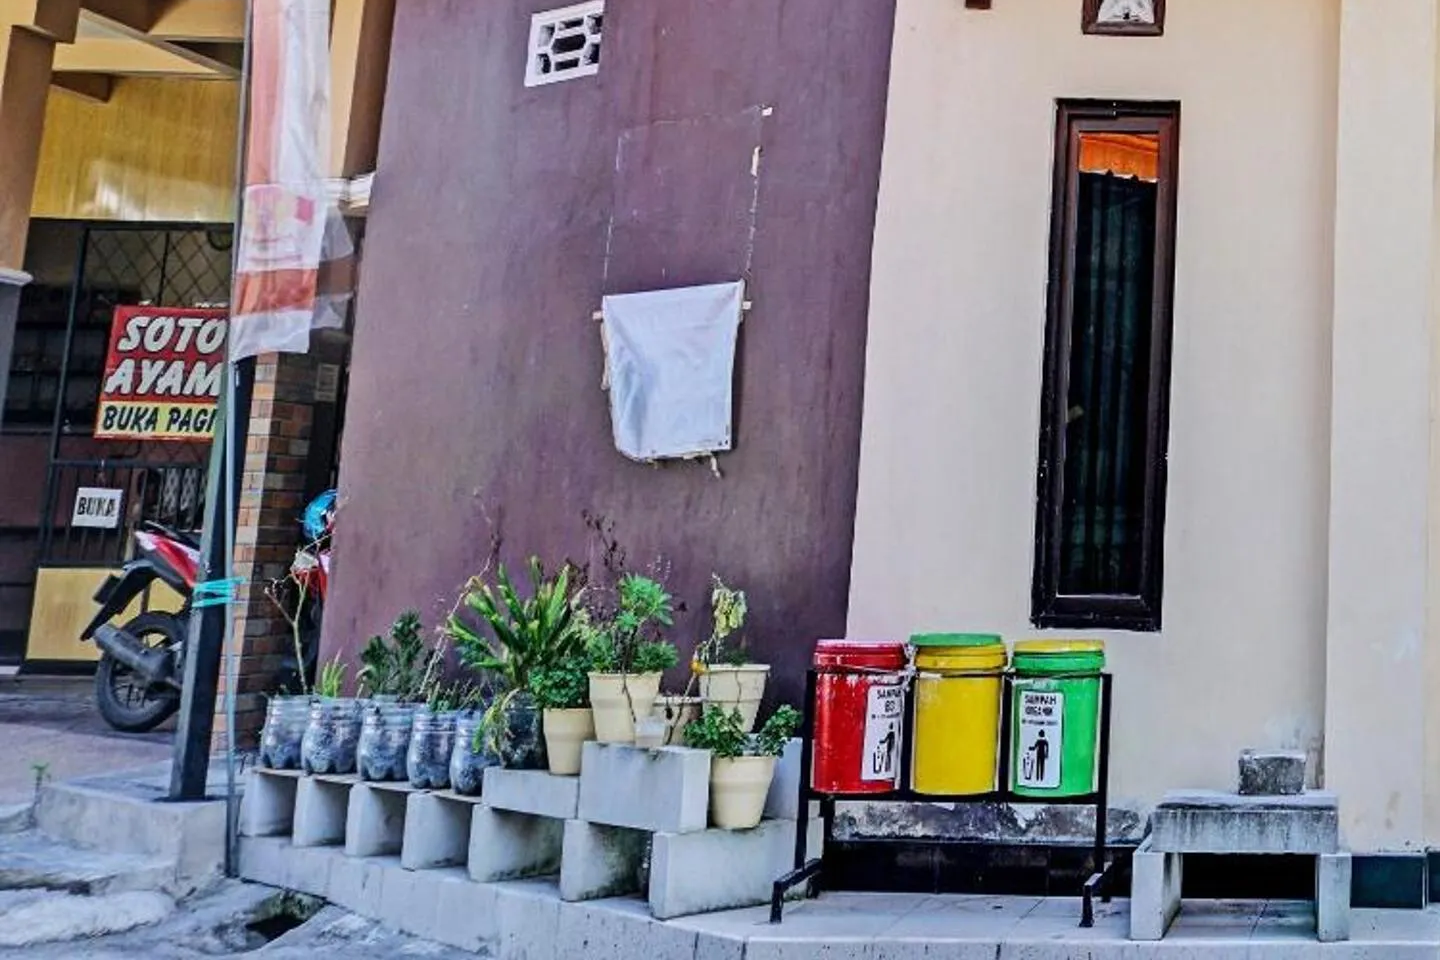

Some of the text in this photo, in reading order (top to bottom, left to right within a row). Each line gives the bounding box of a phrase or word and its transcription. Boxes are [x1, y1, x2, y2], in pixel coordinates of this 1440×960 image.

[117, 315, 228, 355] SOTO
[103, 358, 224, 397] AYAM
[102, 404, 218, 433] BUKA PAGI
